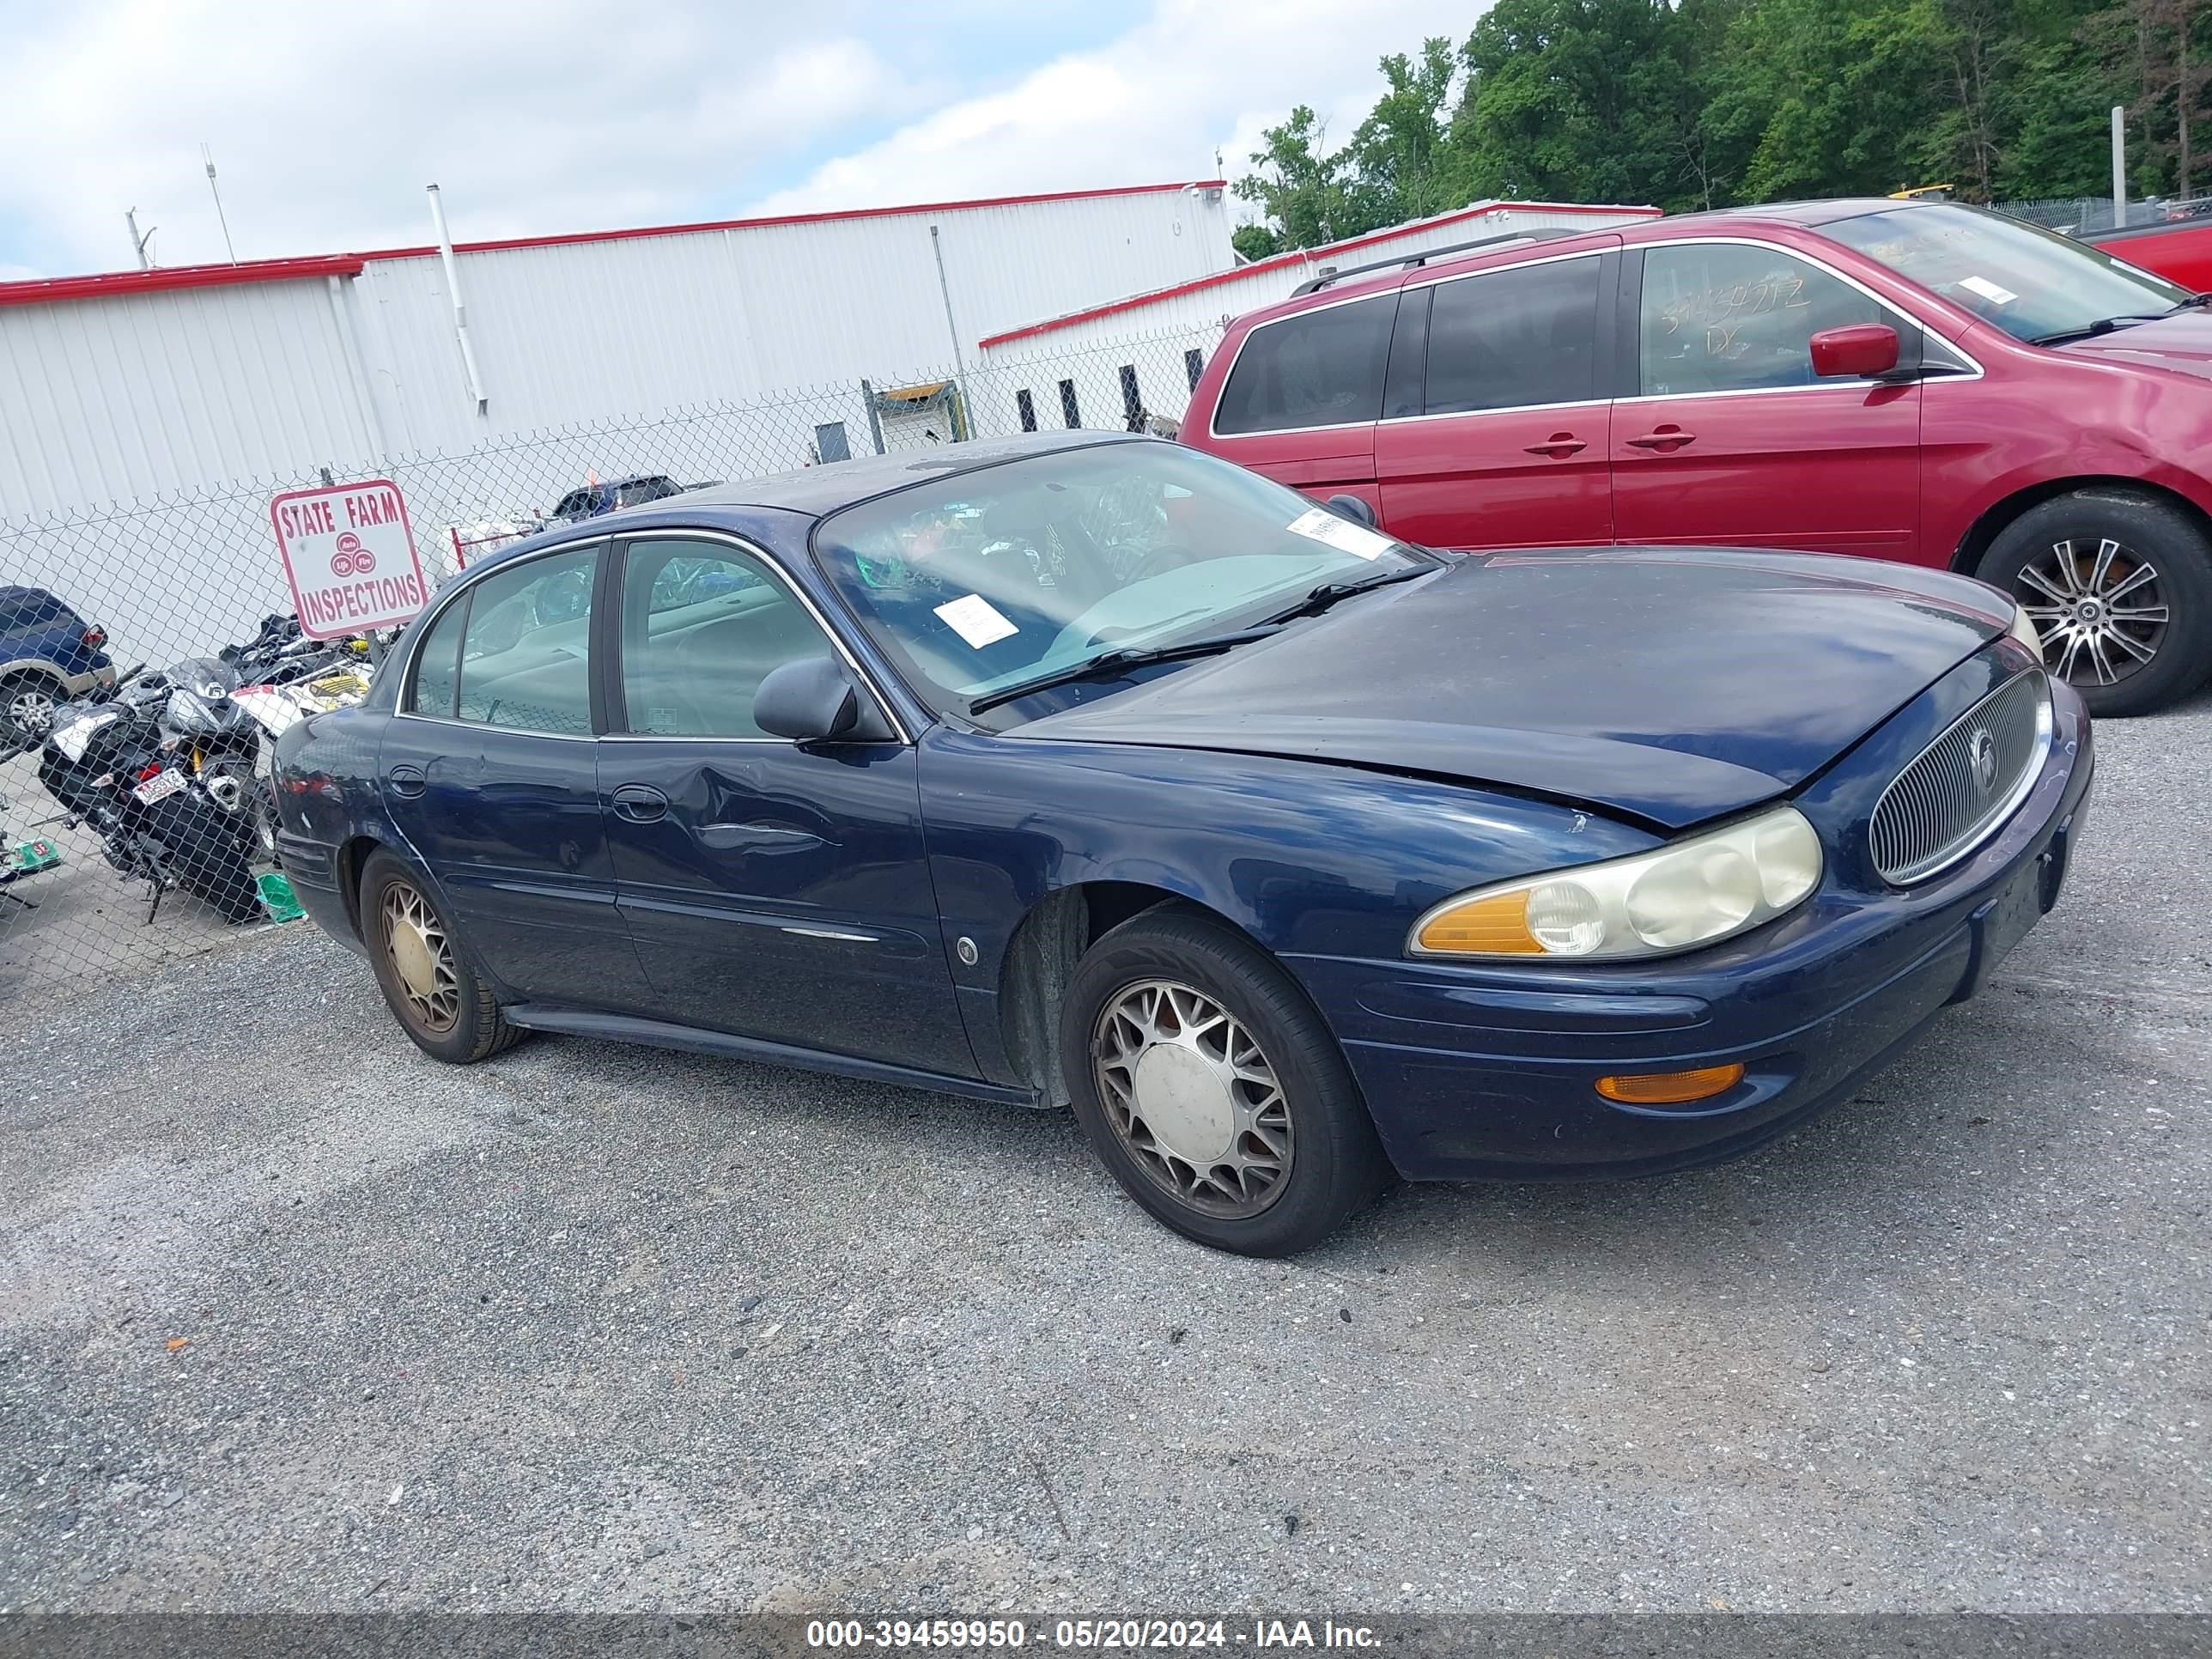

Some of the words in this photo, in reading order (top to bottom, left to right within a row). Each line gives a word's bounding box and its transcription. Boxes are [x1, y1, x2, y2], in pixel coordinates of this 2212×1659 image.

[282, 501, 335, 538] STATE
[345, 492, 398, 528] FARM
[336, 562, 349, 571] Life
[358, 557, 371, 566] Fire
[302, 574, 419, 626] INSPECTIONS
